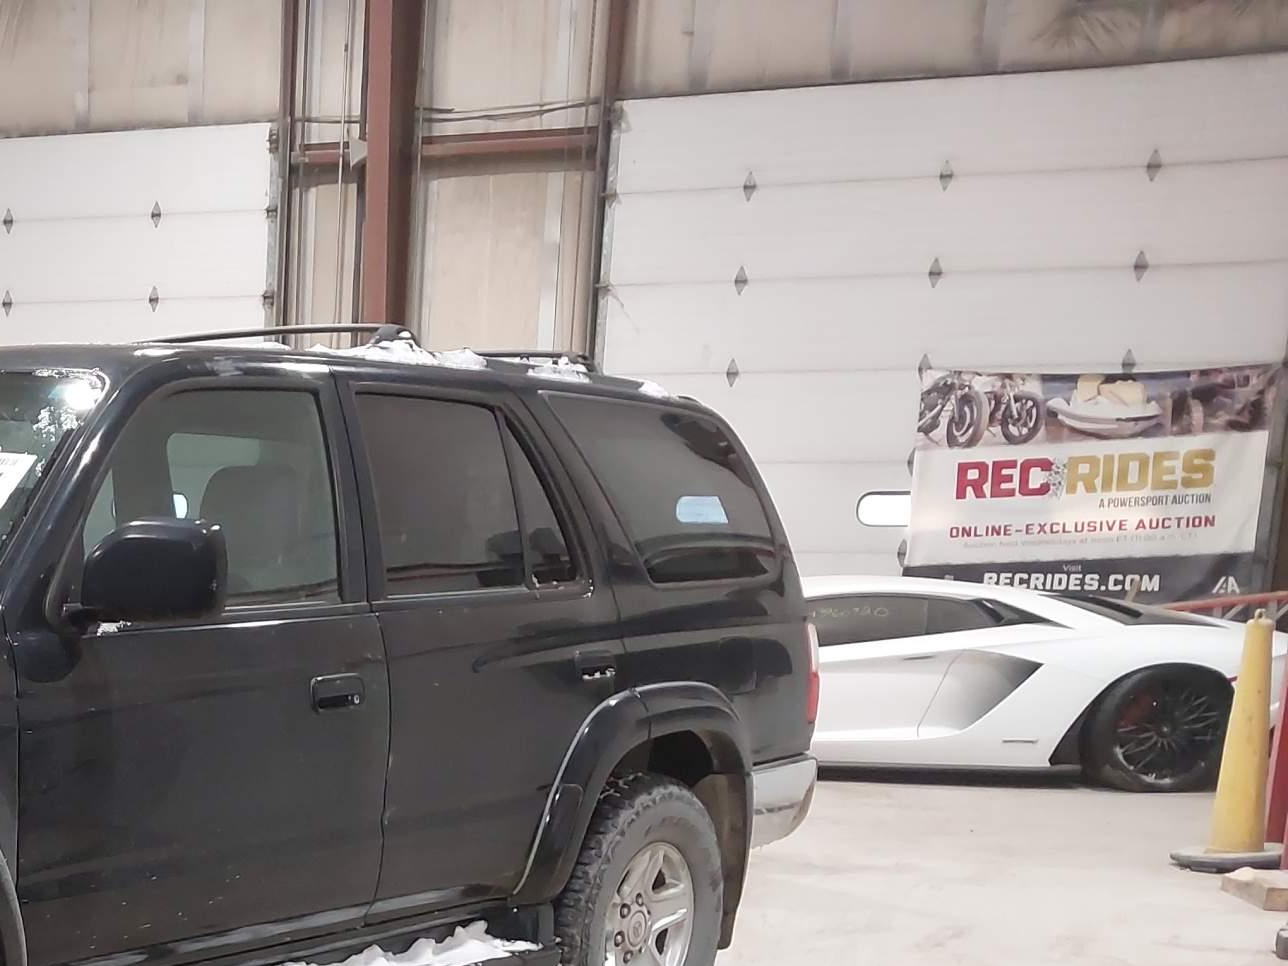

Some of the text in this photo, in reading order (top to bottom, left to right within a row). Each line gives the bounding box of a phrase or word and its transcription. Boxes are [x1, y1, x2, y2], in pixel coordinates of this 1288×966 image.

[955, 448, 1216, 501] REC RIDES
[1098, 492, 1212, 509] A POWERSPORT AUCTION
[949, 514, 1216, 538] ONLINE-EXCLUSIVE AUCTION
[1062, 564, 1082, 572] Visit
[983, 571, 1161, 592] RECRIDES.COM
